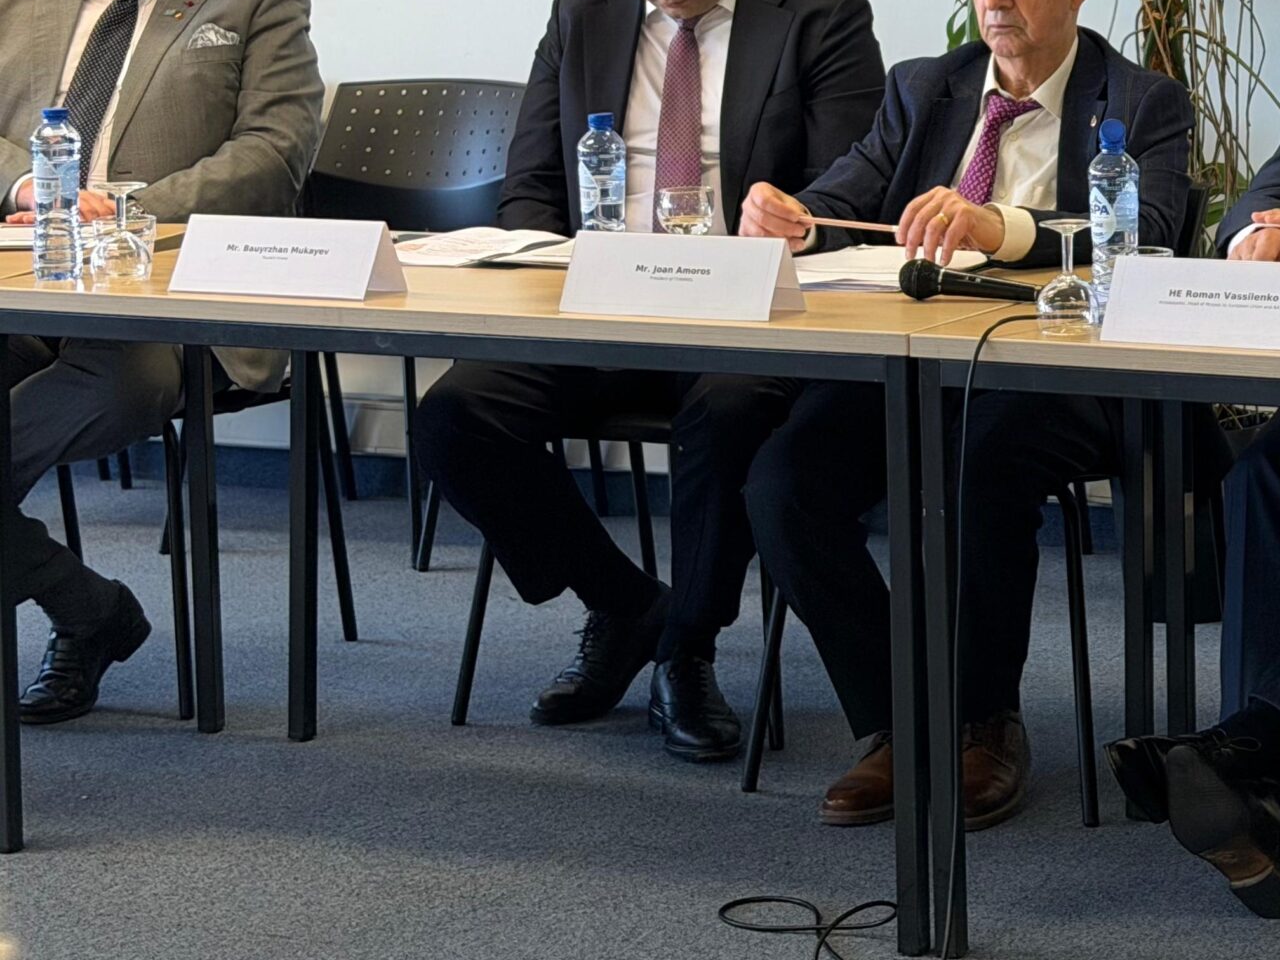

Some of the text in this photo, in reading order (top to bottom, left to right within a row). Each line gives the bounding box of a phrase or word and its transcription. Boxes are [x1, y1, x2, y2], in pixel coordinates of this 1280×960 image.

[226, 243, 330, 256] Mr. Bauyrzhan Mukayev
[635, 264, 711, 276] Mr. Joan Amoros
[1168, 289, 1280, 302] HE Roman Vassilenko
